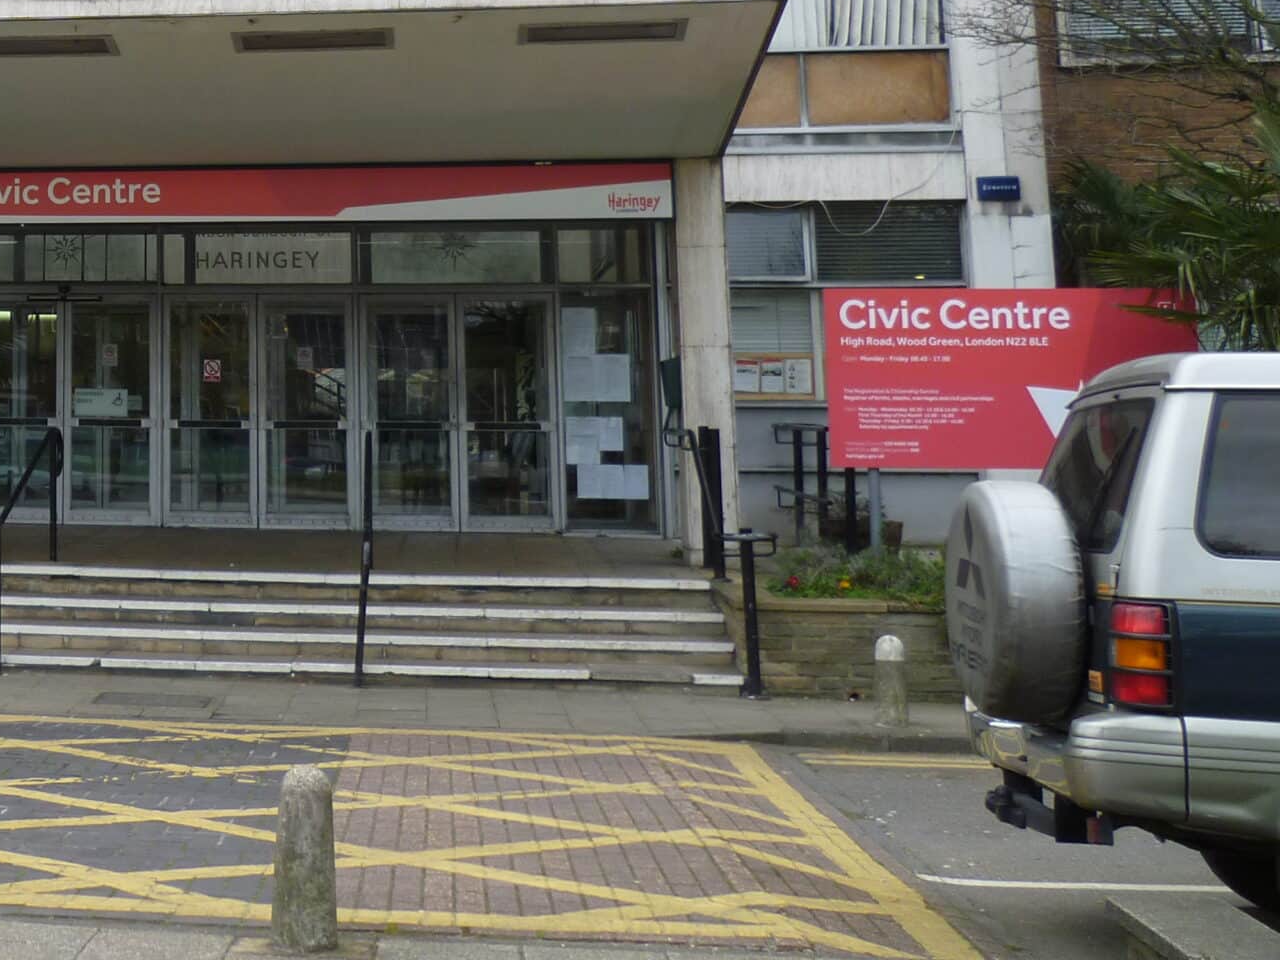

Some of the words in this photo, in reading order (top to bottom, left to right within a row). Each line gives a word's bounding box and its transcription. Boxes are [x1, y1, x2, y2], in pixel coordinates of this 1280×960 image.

[48, 177, 162, 205] Centre
[608, 192, 661, 212] Haringey
[196, 250, 320, 270] HARINGEY
[839, 298, 932, 330] Civic
[939, 298, 1071, 330] Centre
[840, 336, 865, 349] High
[866, 336, 895, 348] Road,
[896, 336, 927, 346] Wood
[928, 337, 964, 348] Green,
[965, 336, 1005, 346] London
[1006, 337, 1026, 347] N22
